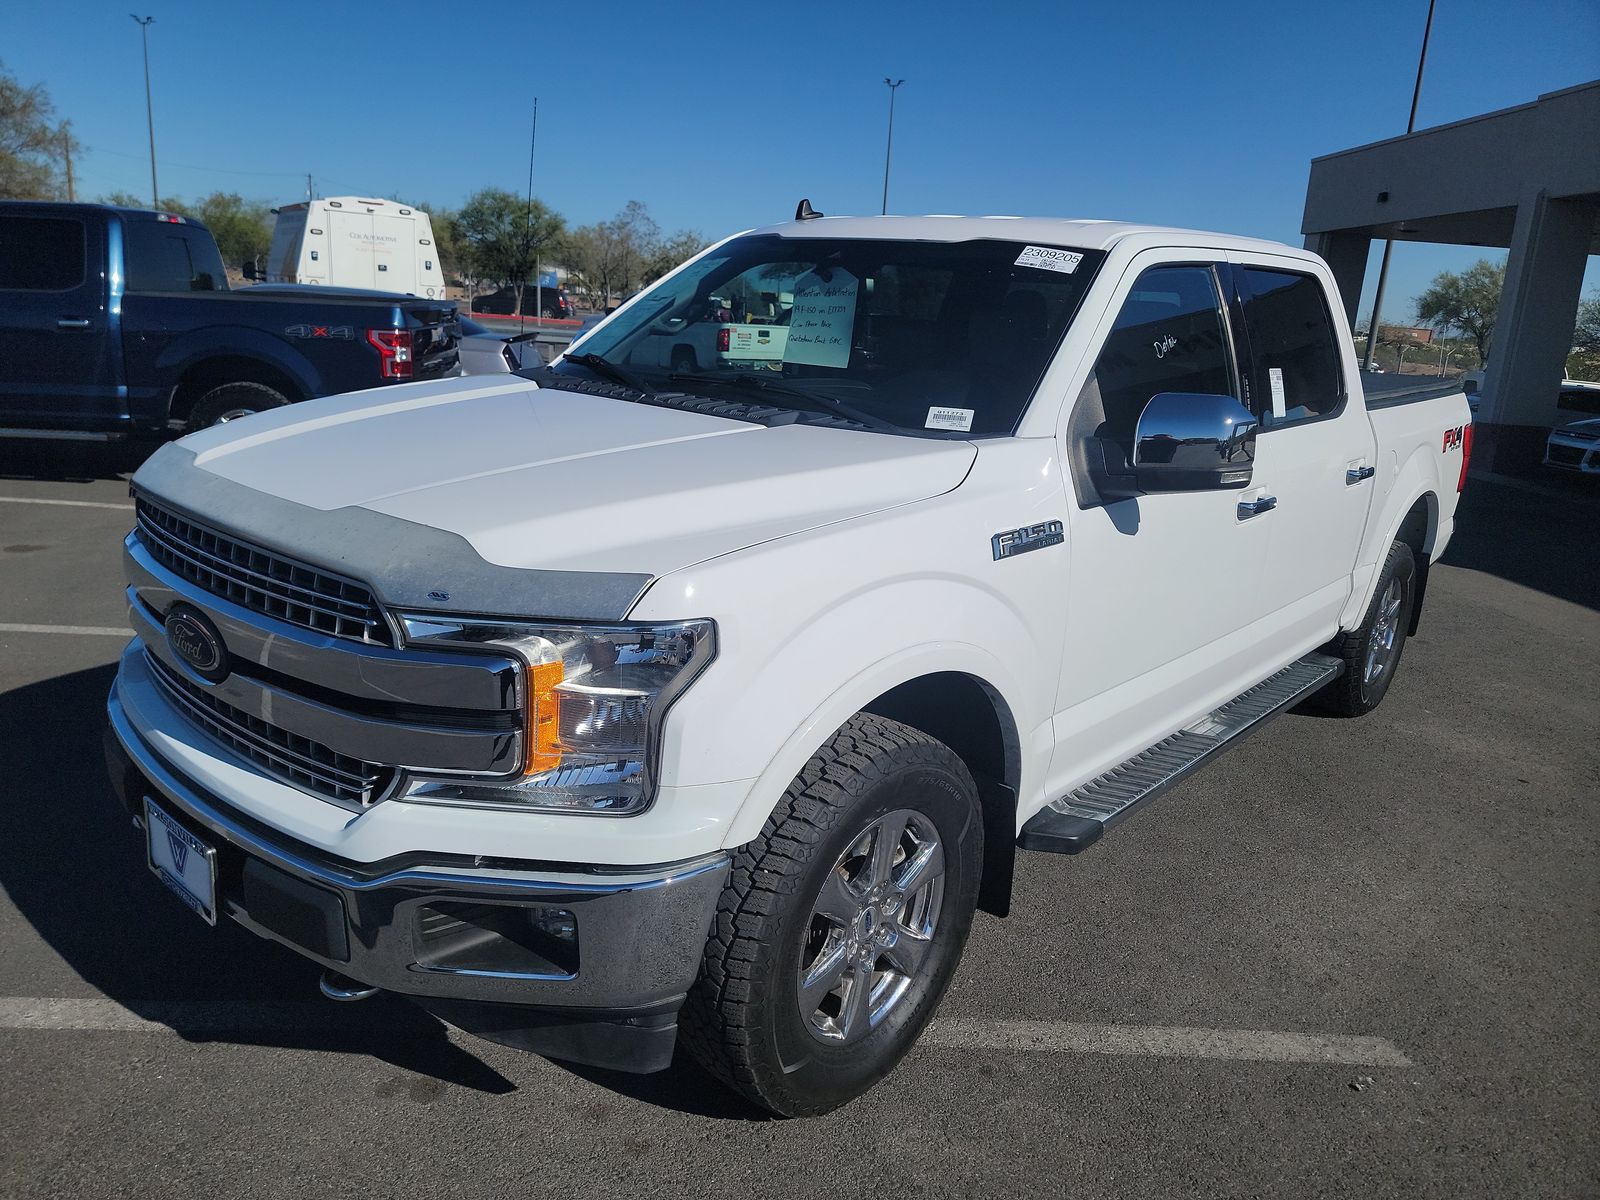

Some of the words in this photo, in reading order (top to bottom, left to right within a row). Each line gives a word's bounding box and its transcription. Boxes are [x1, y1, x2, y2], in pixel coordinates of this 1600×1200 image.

[1023, 247, 1080, 264] 2309205
[1442, 425, 1463, 453] FX4
[174, 623, 203, 660] Ford
